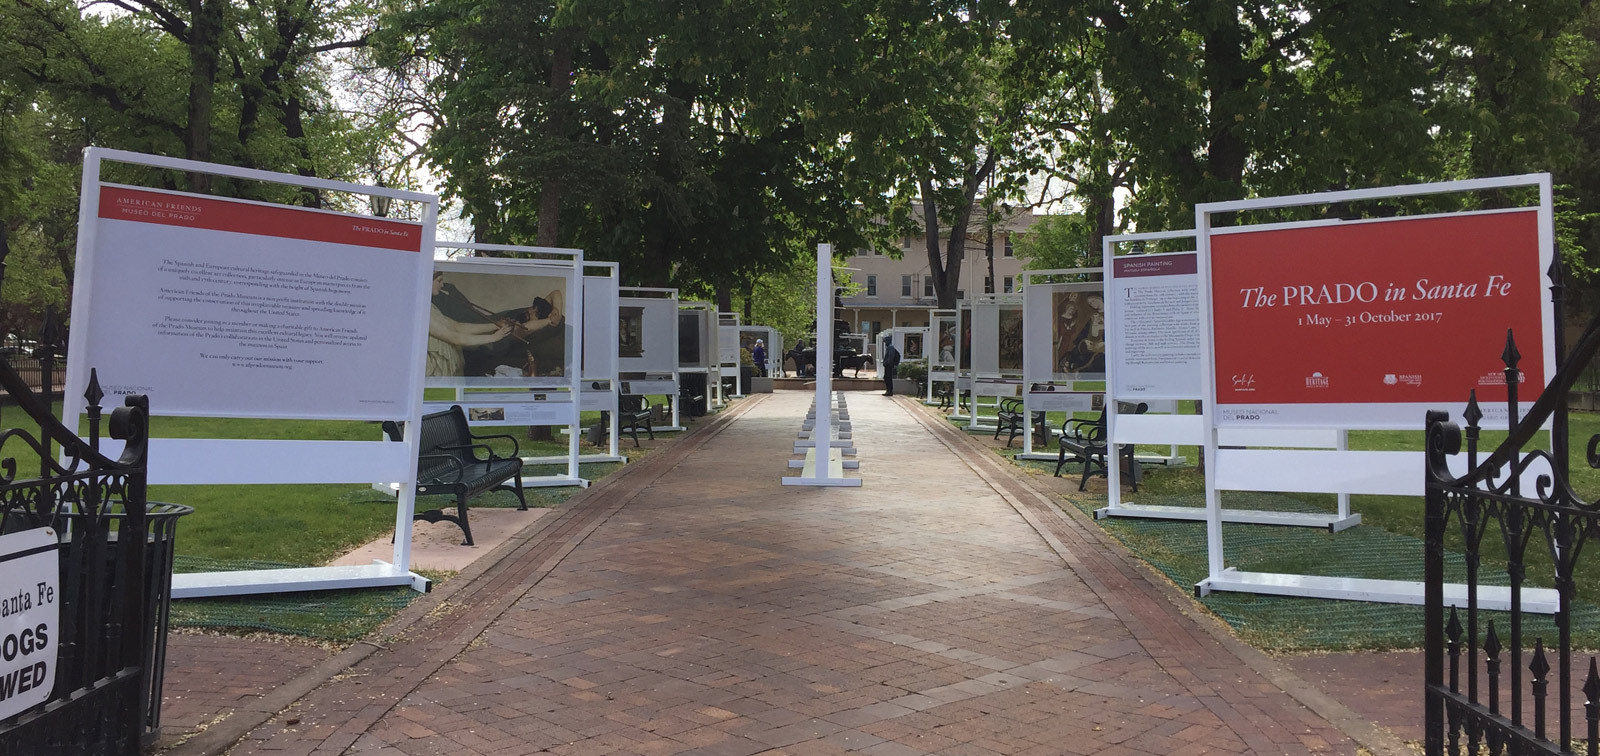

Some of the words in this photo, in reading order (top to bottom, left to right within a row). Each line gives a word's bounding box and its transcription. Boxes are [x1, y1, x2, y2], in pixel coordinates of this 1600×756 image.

[116, 198, 162, 208] AMERICAN
[166, 202, 202, 212] FRIENDS
[122, 208, 148, 216] MUSEO
[169, 213, 195, 221] PRADO
[362, 226, 384, 234] PRADO
[1240, 287, 1277, 308] The
[1282, 282, 1378, 306] PRADO
[1384, 283, 1406, 302] in
[1412, 279, 1478, 300] Santa
[1484, 274, 1512, 297] Fe
[1298, 317, 1303, 326] 1
[1306, 314, 1332, 328] May
[1345, 316, 1356, 327] 31
[1360, 310, 1412, 324] October
[1415, 311, 1443, 324] 2017
[1306, 376, 1329, 386] HERITAGE
[0, 588, 32, 618] anta
[37, 582, 54, 606] Fe
[0, 623, 48, 662] OGS
